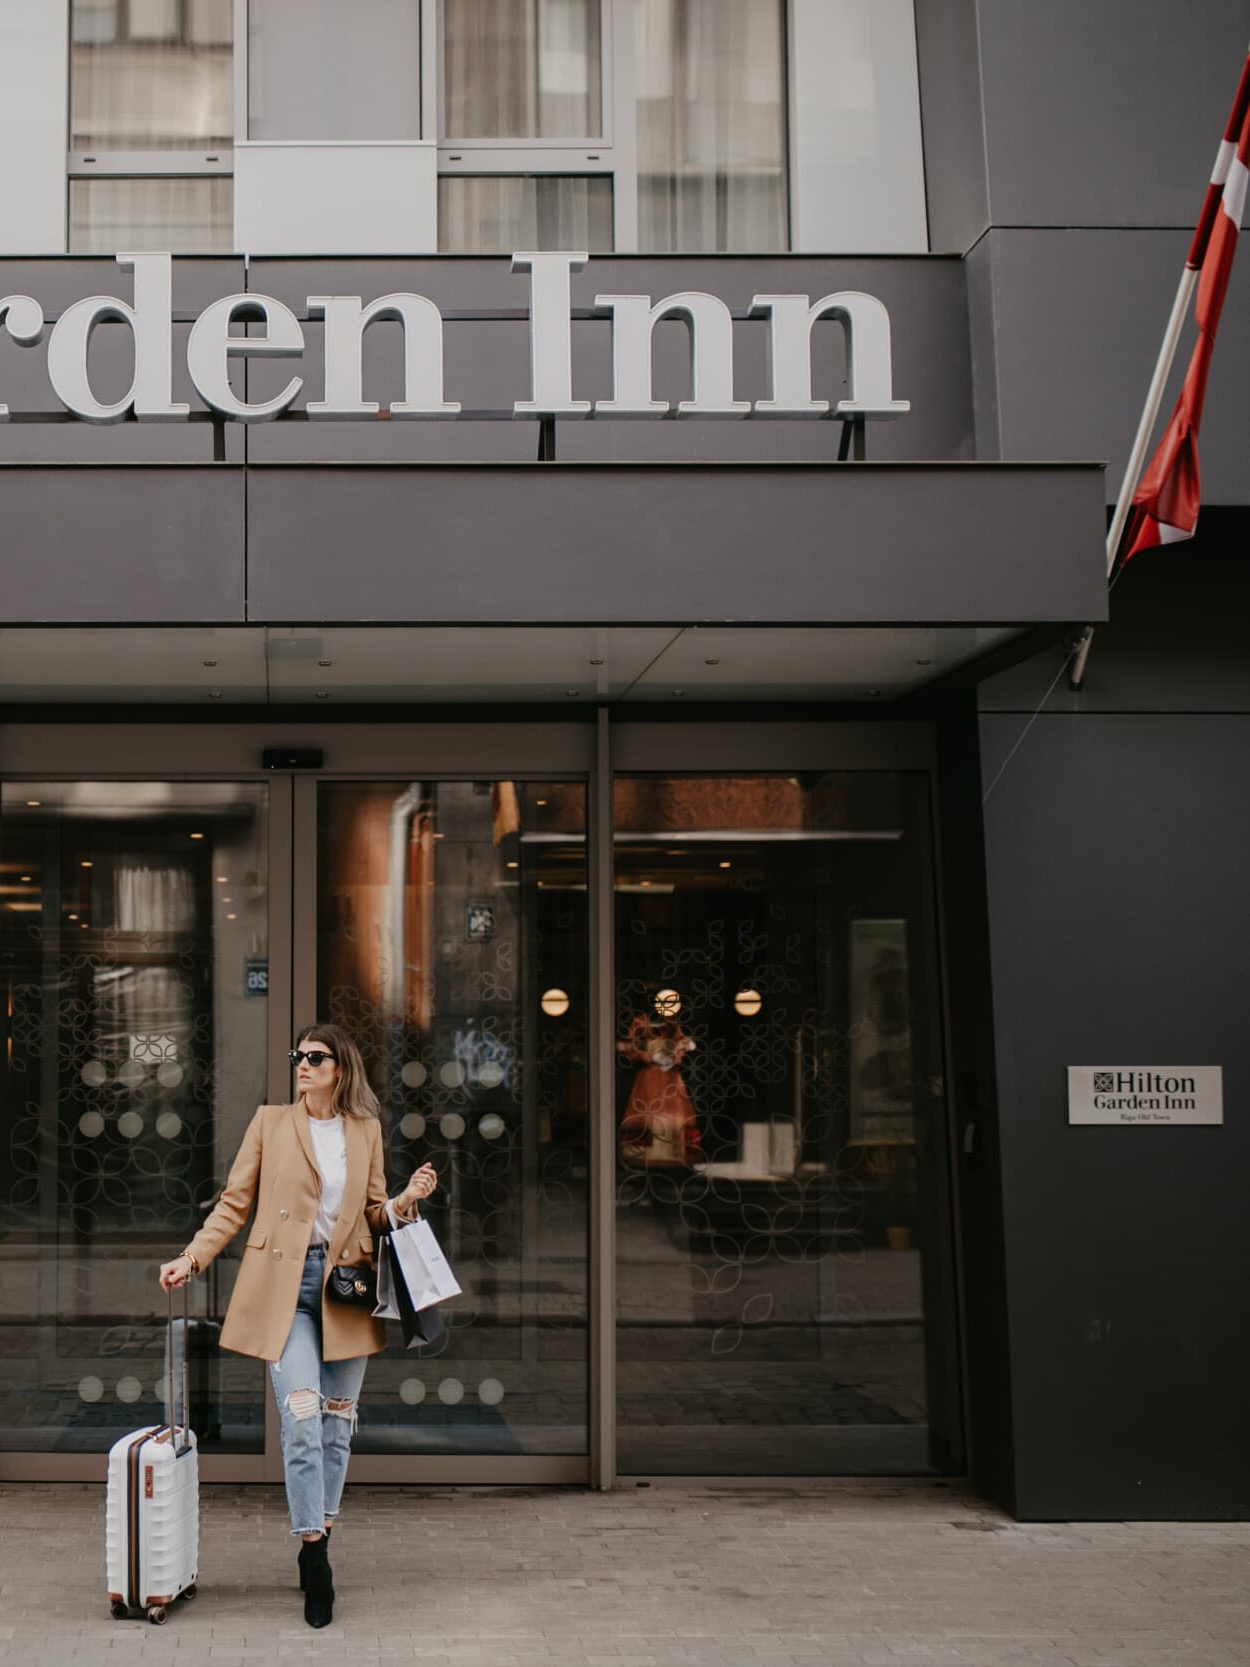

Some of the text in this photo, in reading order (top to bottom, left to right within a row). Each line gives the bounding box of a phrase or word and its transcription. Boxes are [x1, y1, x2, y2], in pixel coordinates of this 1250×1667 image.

[511, 251, 910, 418] Inn
[1117, 1072, 1196, 1093] Hilton
[1094, 1095, 1196, 1110] Garden Inn
